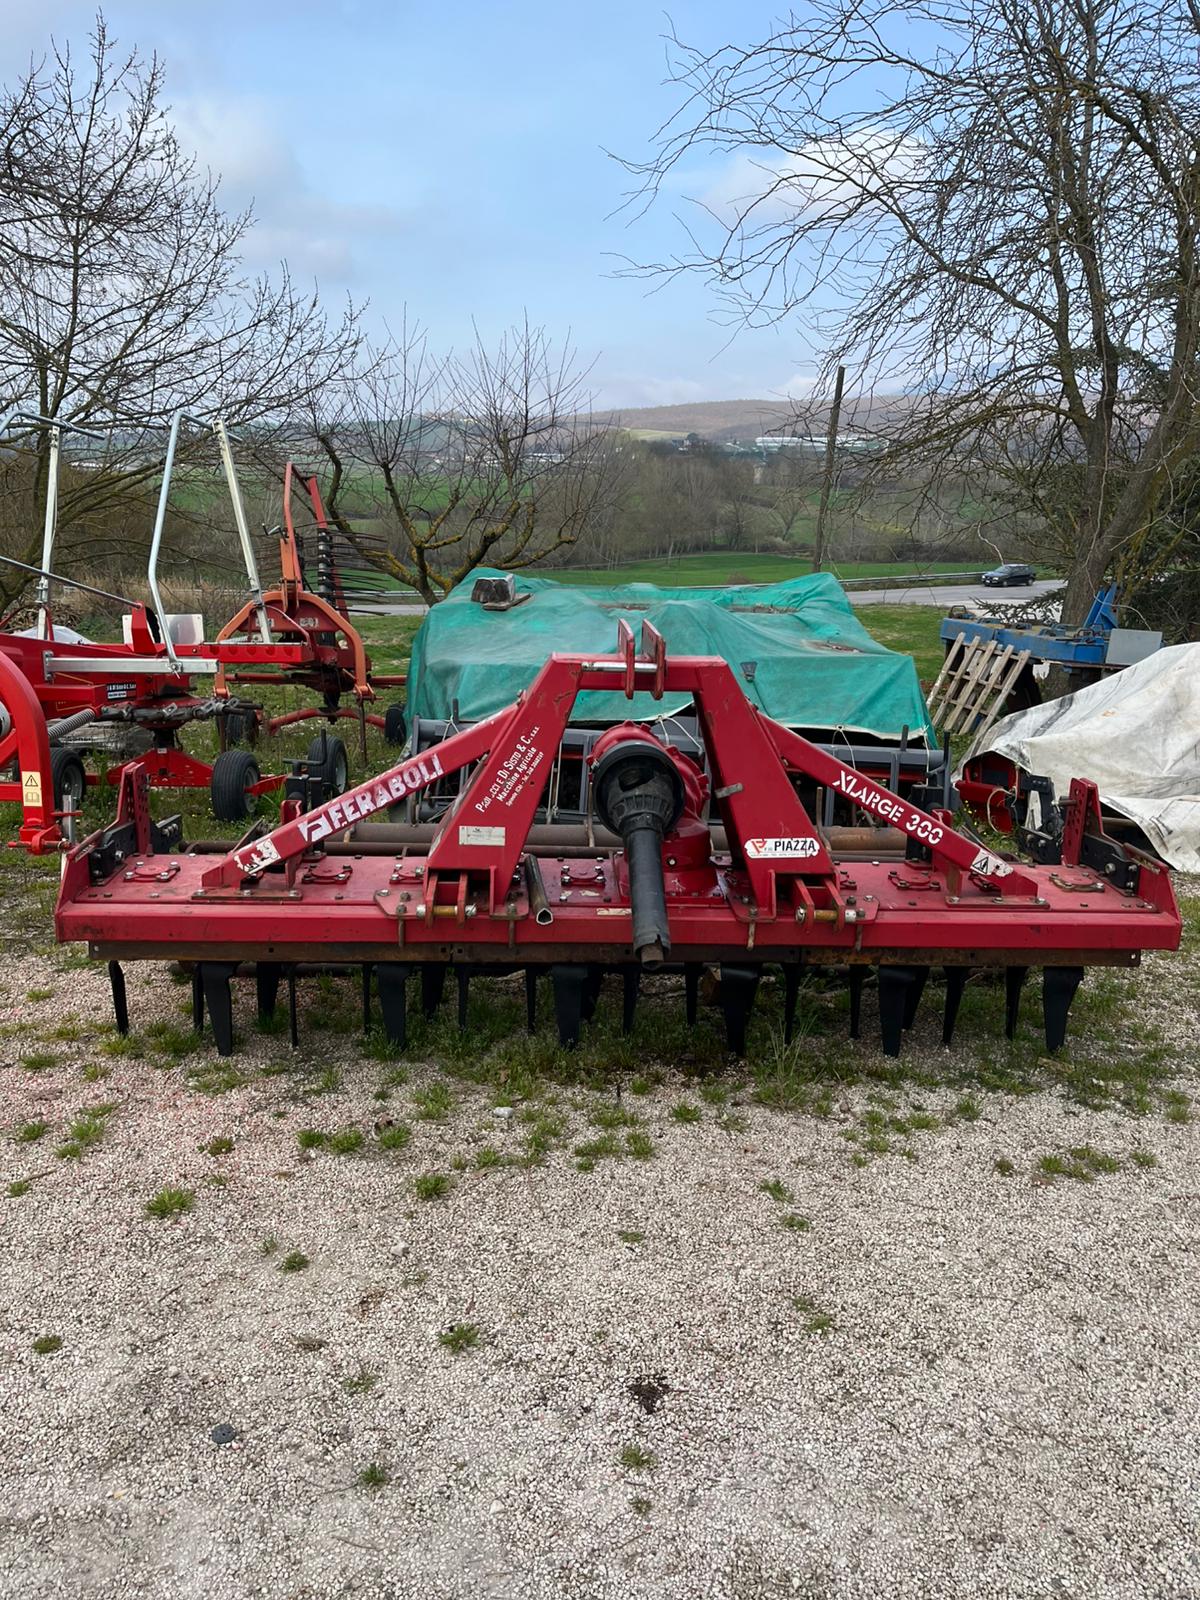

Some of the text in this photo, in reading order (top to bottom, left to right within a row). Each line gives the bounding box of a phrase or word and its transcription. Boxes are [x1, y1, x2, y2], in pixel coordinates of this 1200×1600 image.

[516, 744, 526, 752] &
[520, 736, 533, 744] C.
[503, 752, 521, 770] SISTO
[496, 747, 536, 802] Macchine Agricole
[328, 754, 444, 829] FERABOLI
[832, 770, 944, 845] XLARGE 300
[774, 840, 816, 852] PIAZZA
